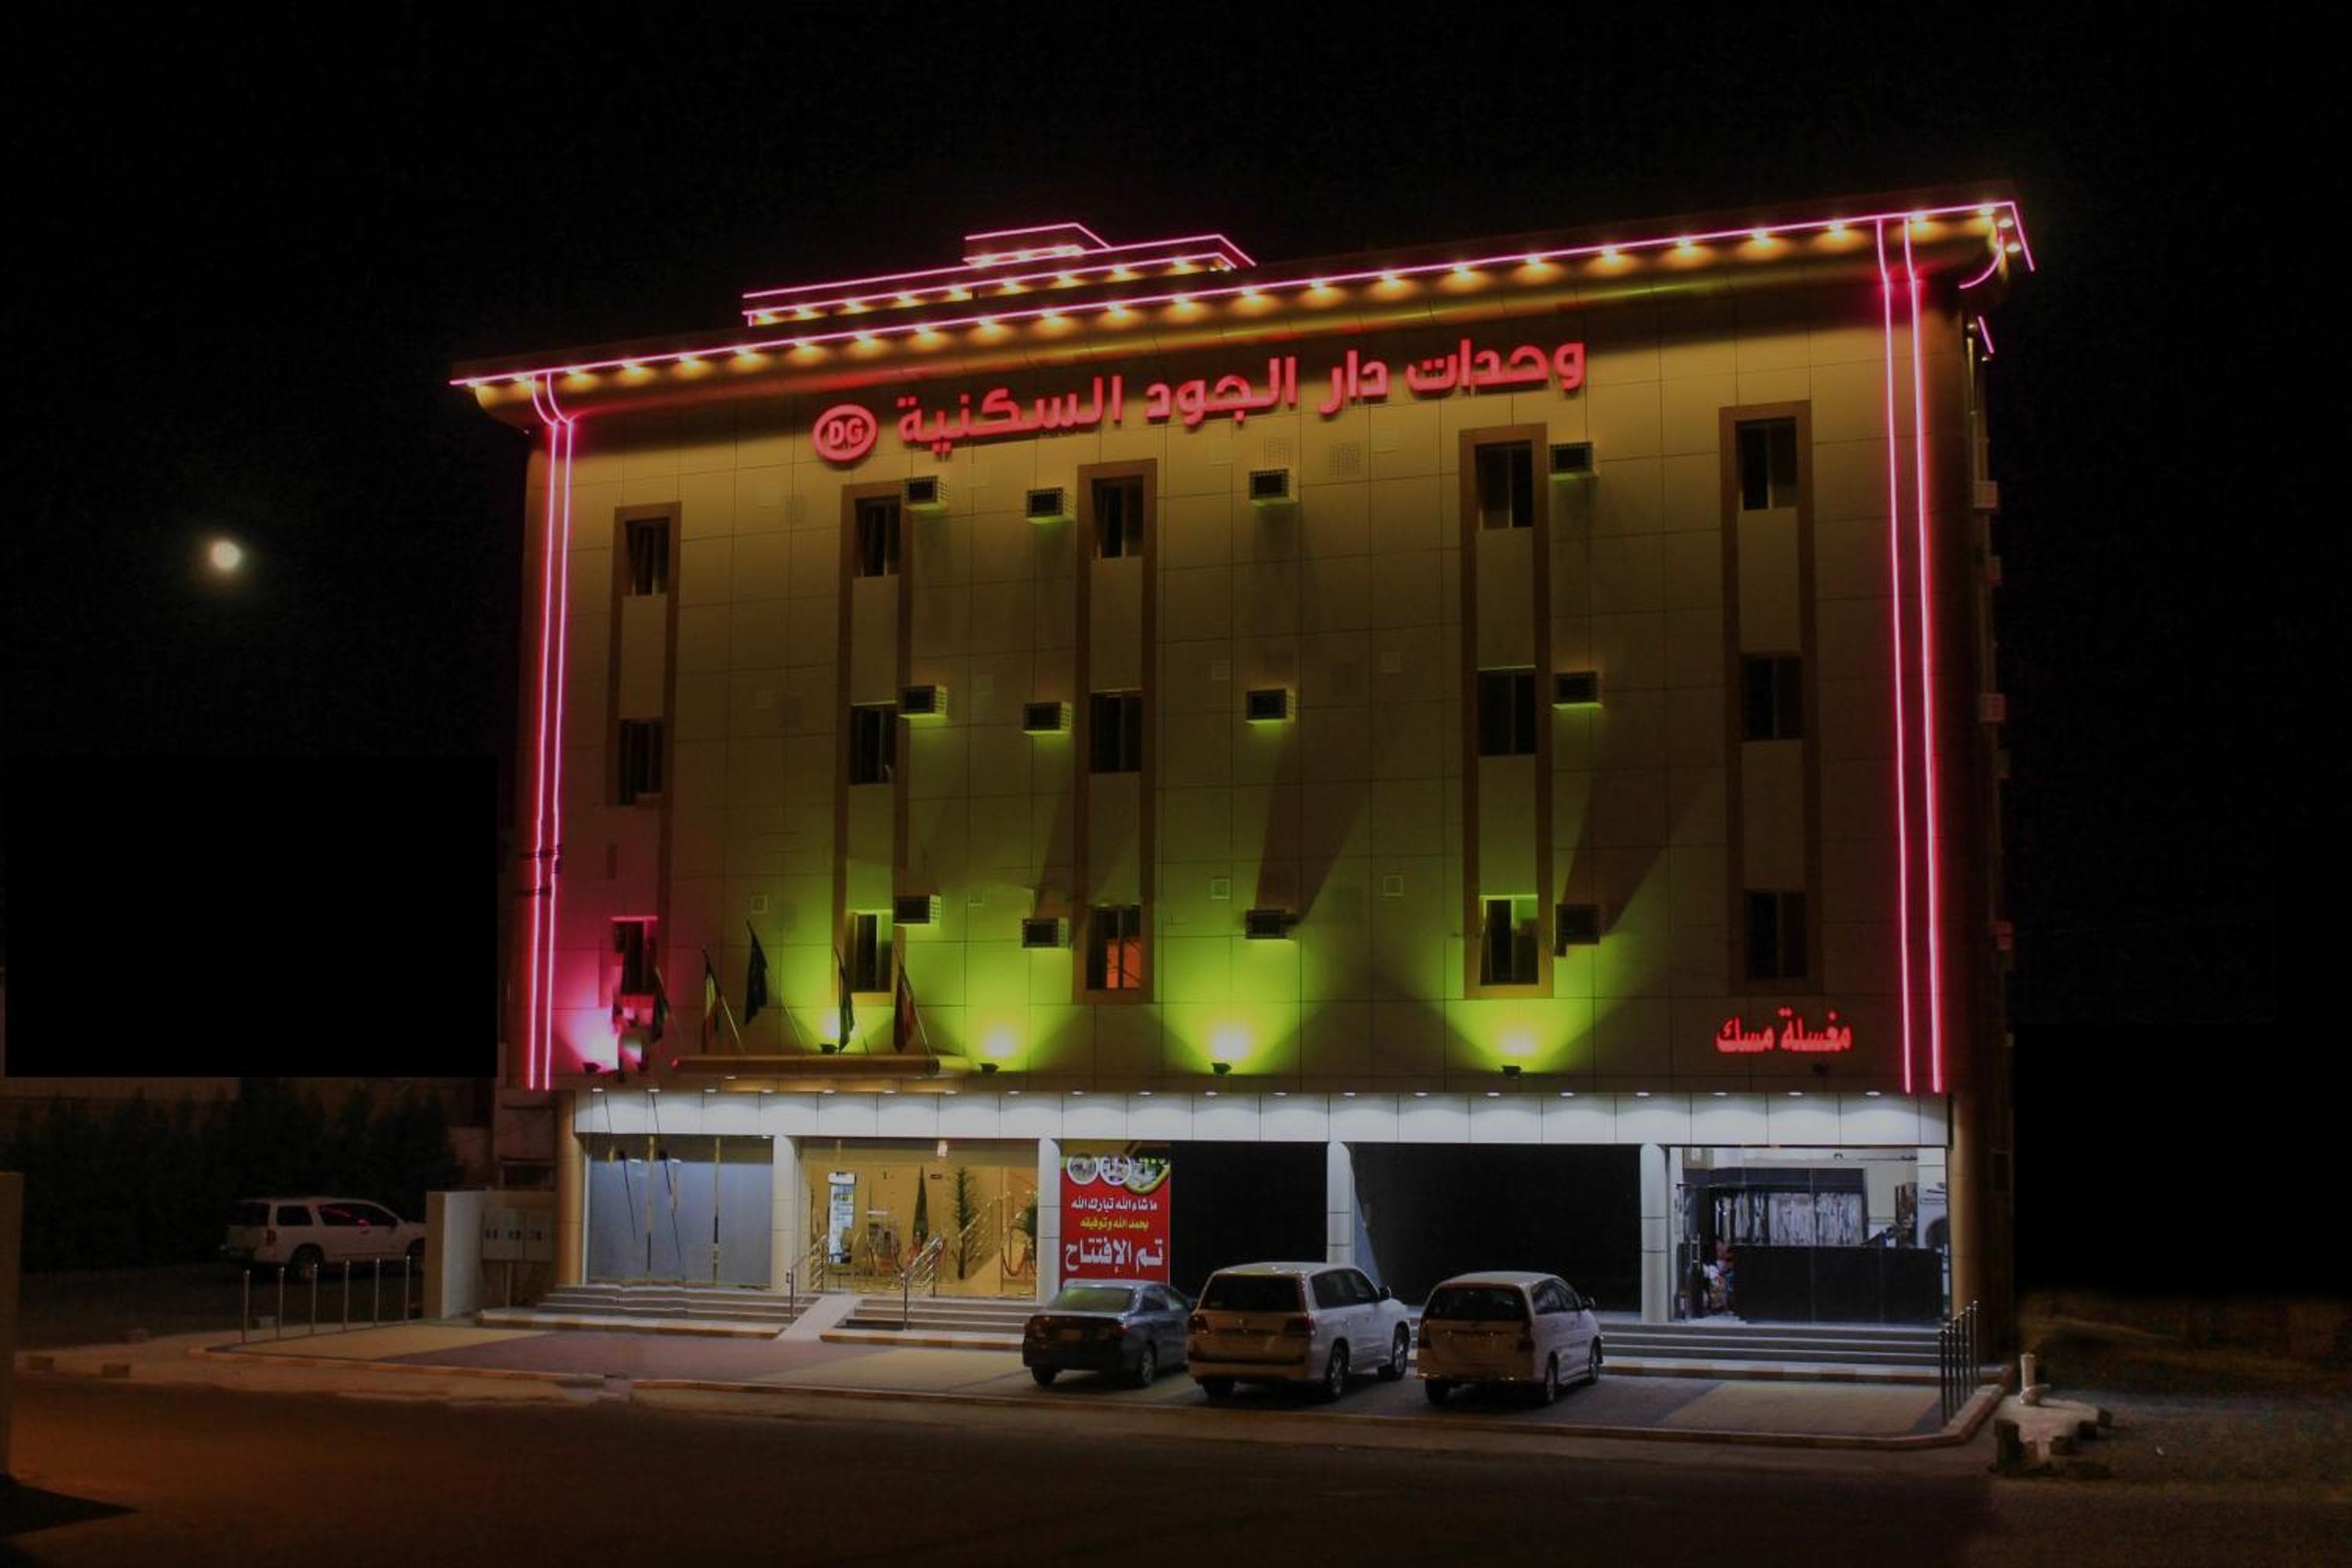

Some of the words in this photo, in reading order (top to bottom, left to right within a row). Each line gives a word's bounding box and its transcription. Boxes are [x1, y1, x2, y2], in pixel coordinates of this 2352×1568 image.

[1319, 348, 1388, 416] دار
[1406, 338, 1586, 393] وحدات
[1145, 356, 1297, 426] الجود
[897, 374, 1123, 452] السكنية
[1715, 1016, 1775, 1052] مسك
[1777, 1006, 1852, 1051] مغسلة
[1071, 1196, 1087, 1208] الله
[1088, 1196, 1114, 1213] تبارك
[1116, 1198, 1131, 1210] الله
[1112, 1218, 1128, 1229] الله
